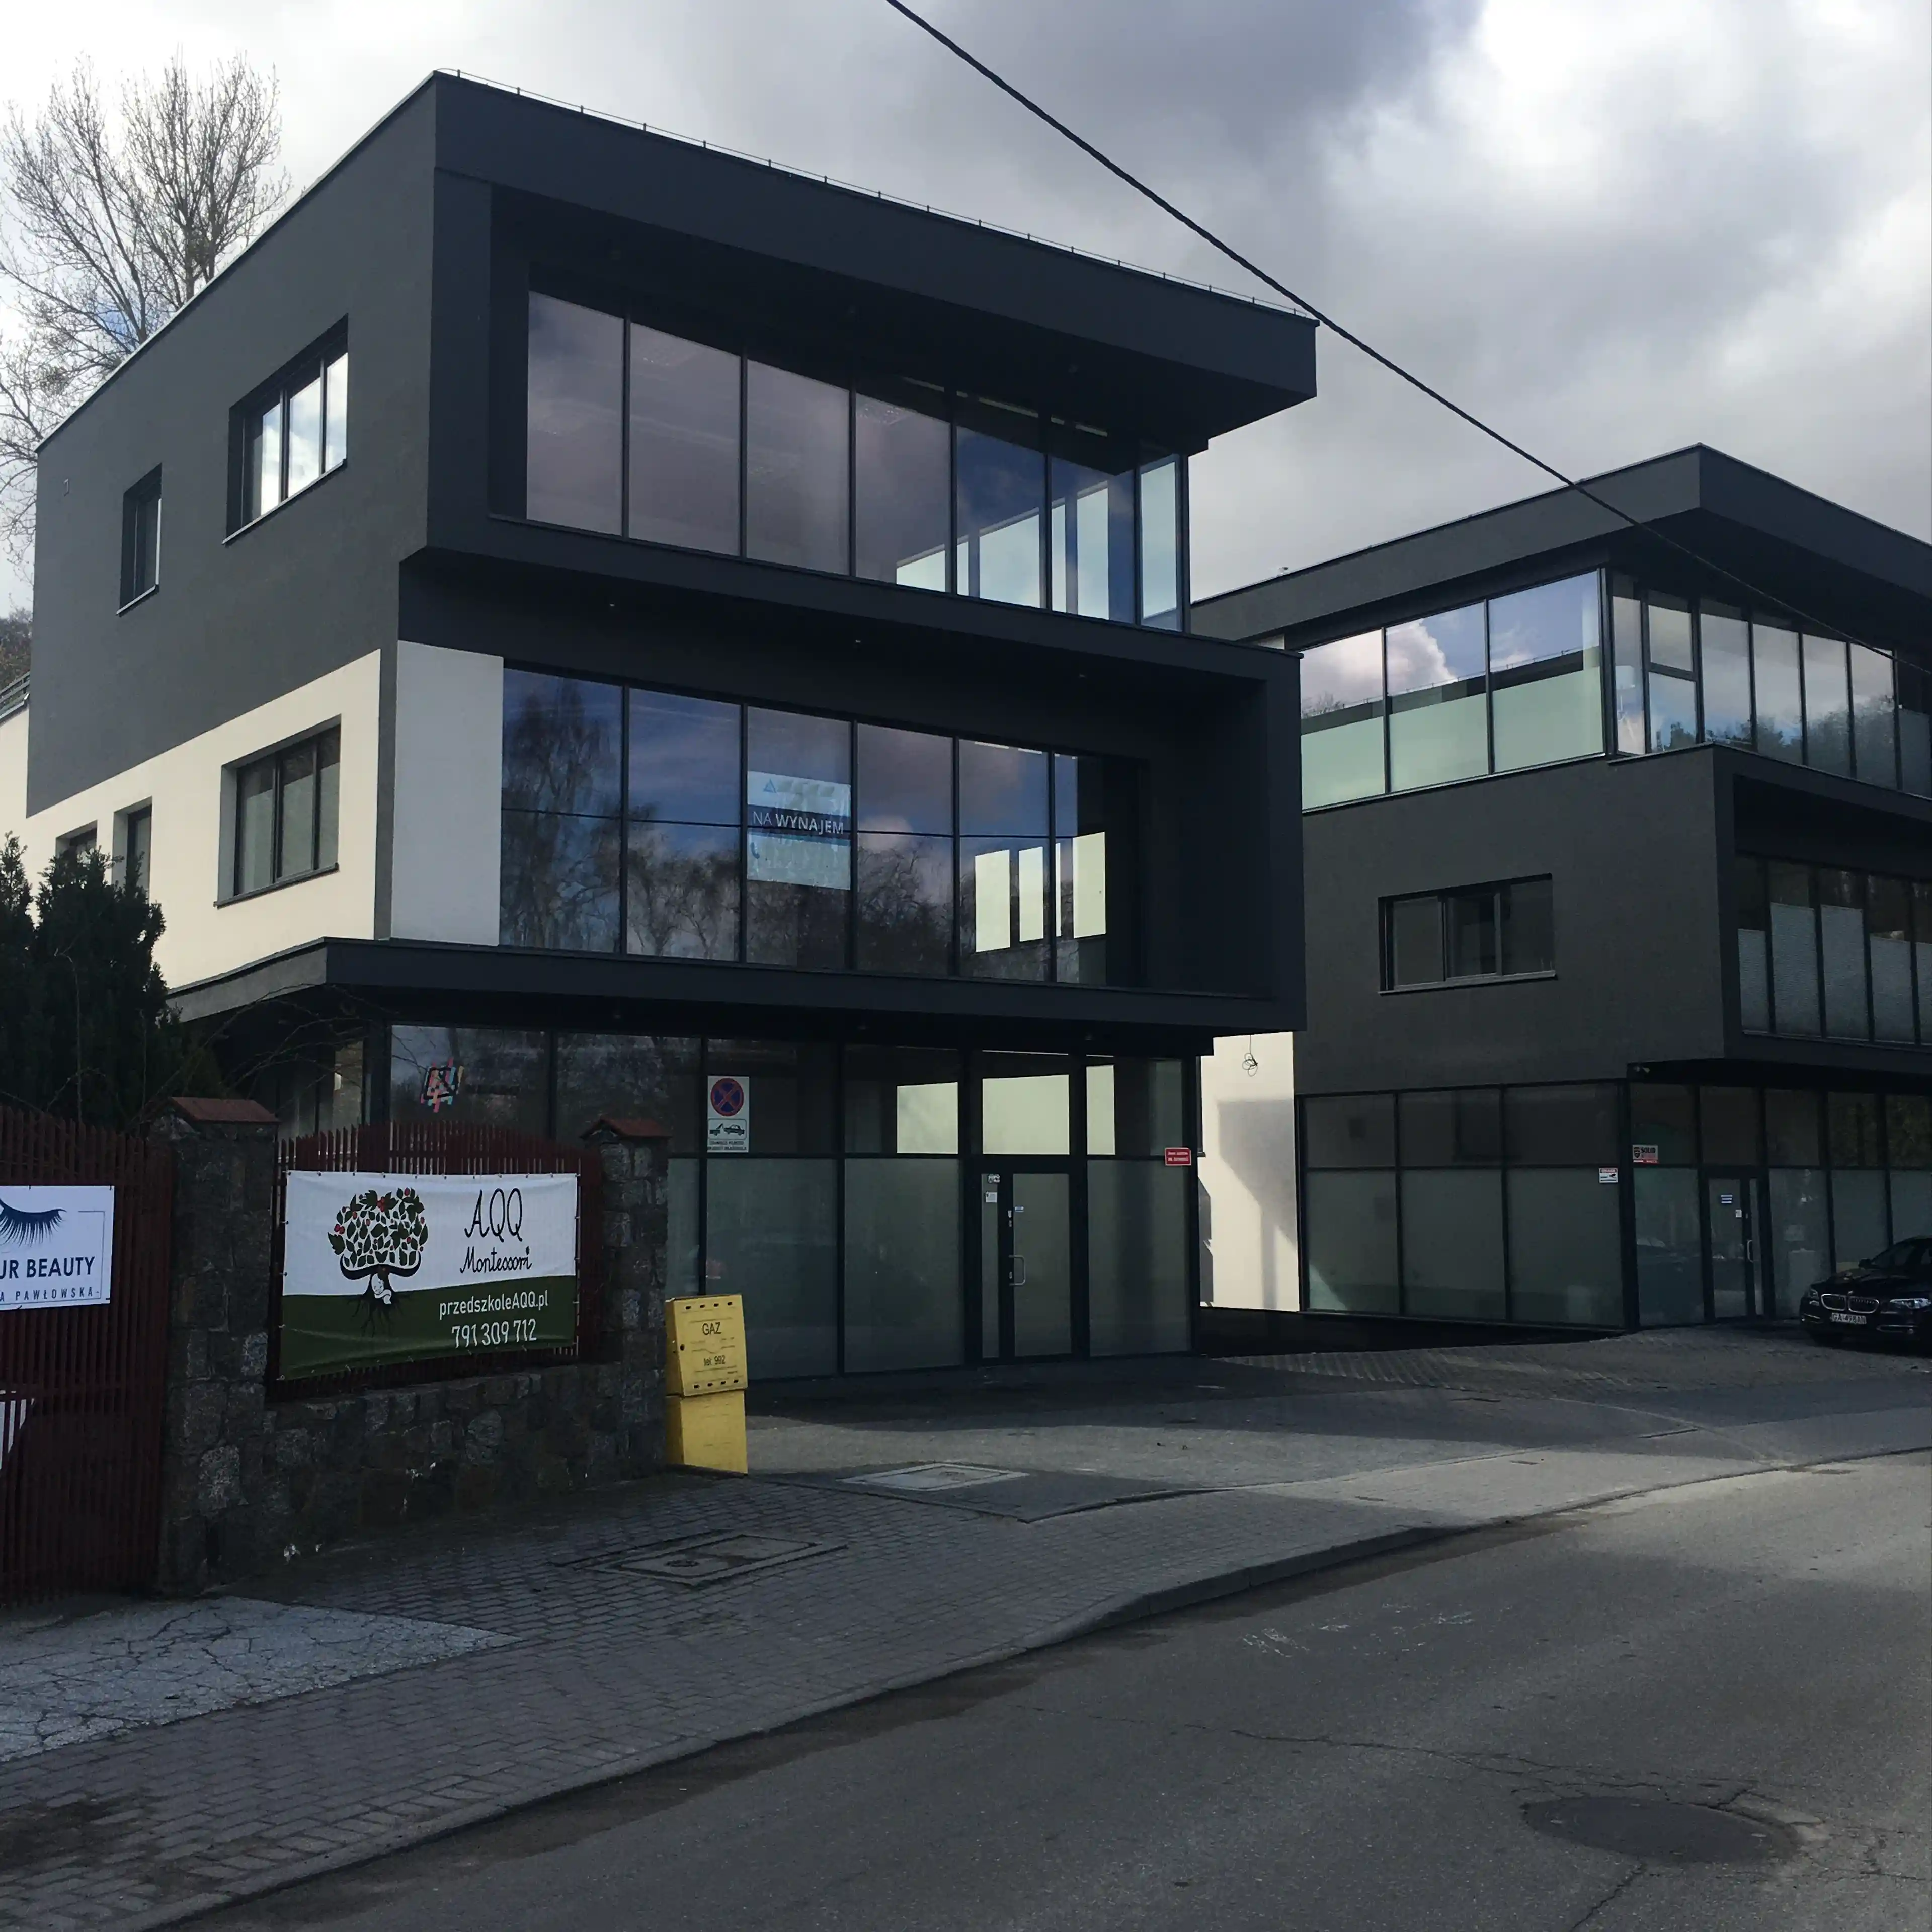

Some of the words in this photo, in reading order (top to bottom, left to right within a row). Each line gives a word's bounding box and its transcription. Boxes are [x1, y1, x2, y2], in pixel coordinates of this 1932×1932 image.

[753, 811, 772, 826] NA
[775, 813, 843, 835] WYNAJEM
[464, 1188, 523, 1243] AQQ
[26, 1256, 95, 1278] BEAUTY
[459, 1246, 532, 1274] Montessori
[439, 1290, 548, 1320] przedszkoleAQQ.pl
[451, 1323, 478, 1349] 791
[480, 1320, 510, 1346] 309
[513, 1318, 537, 1343] 712
[702, 1322, 722, 1335] GAZ
[714, 1355, 726, 1365] 992
